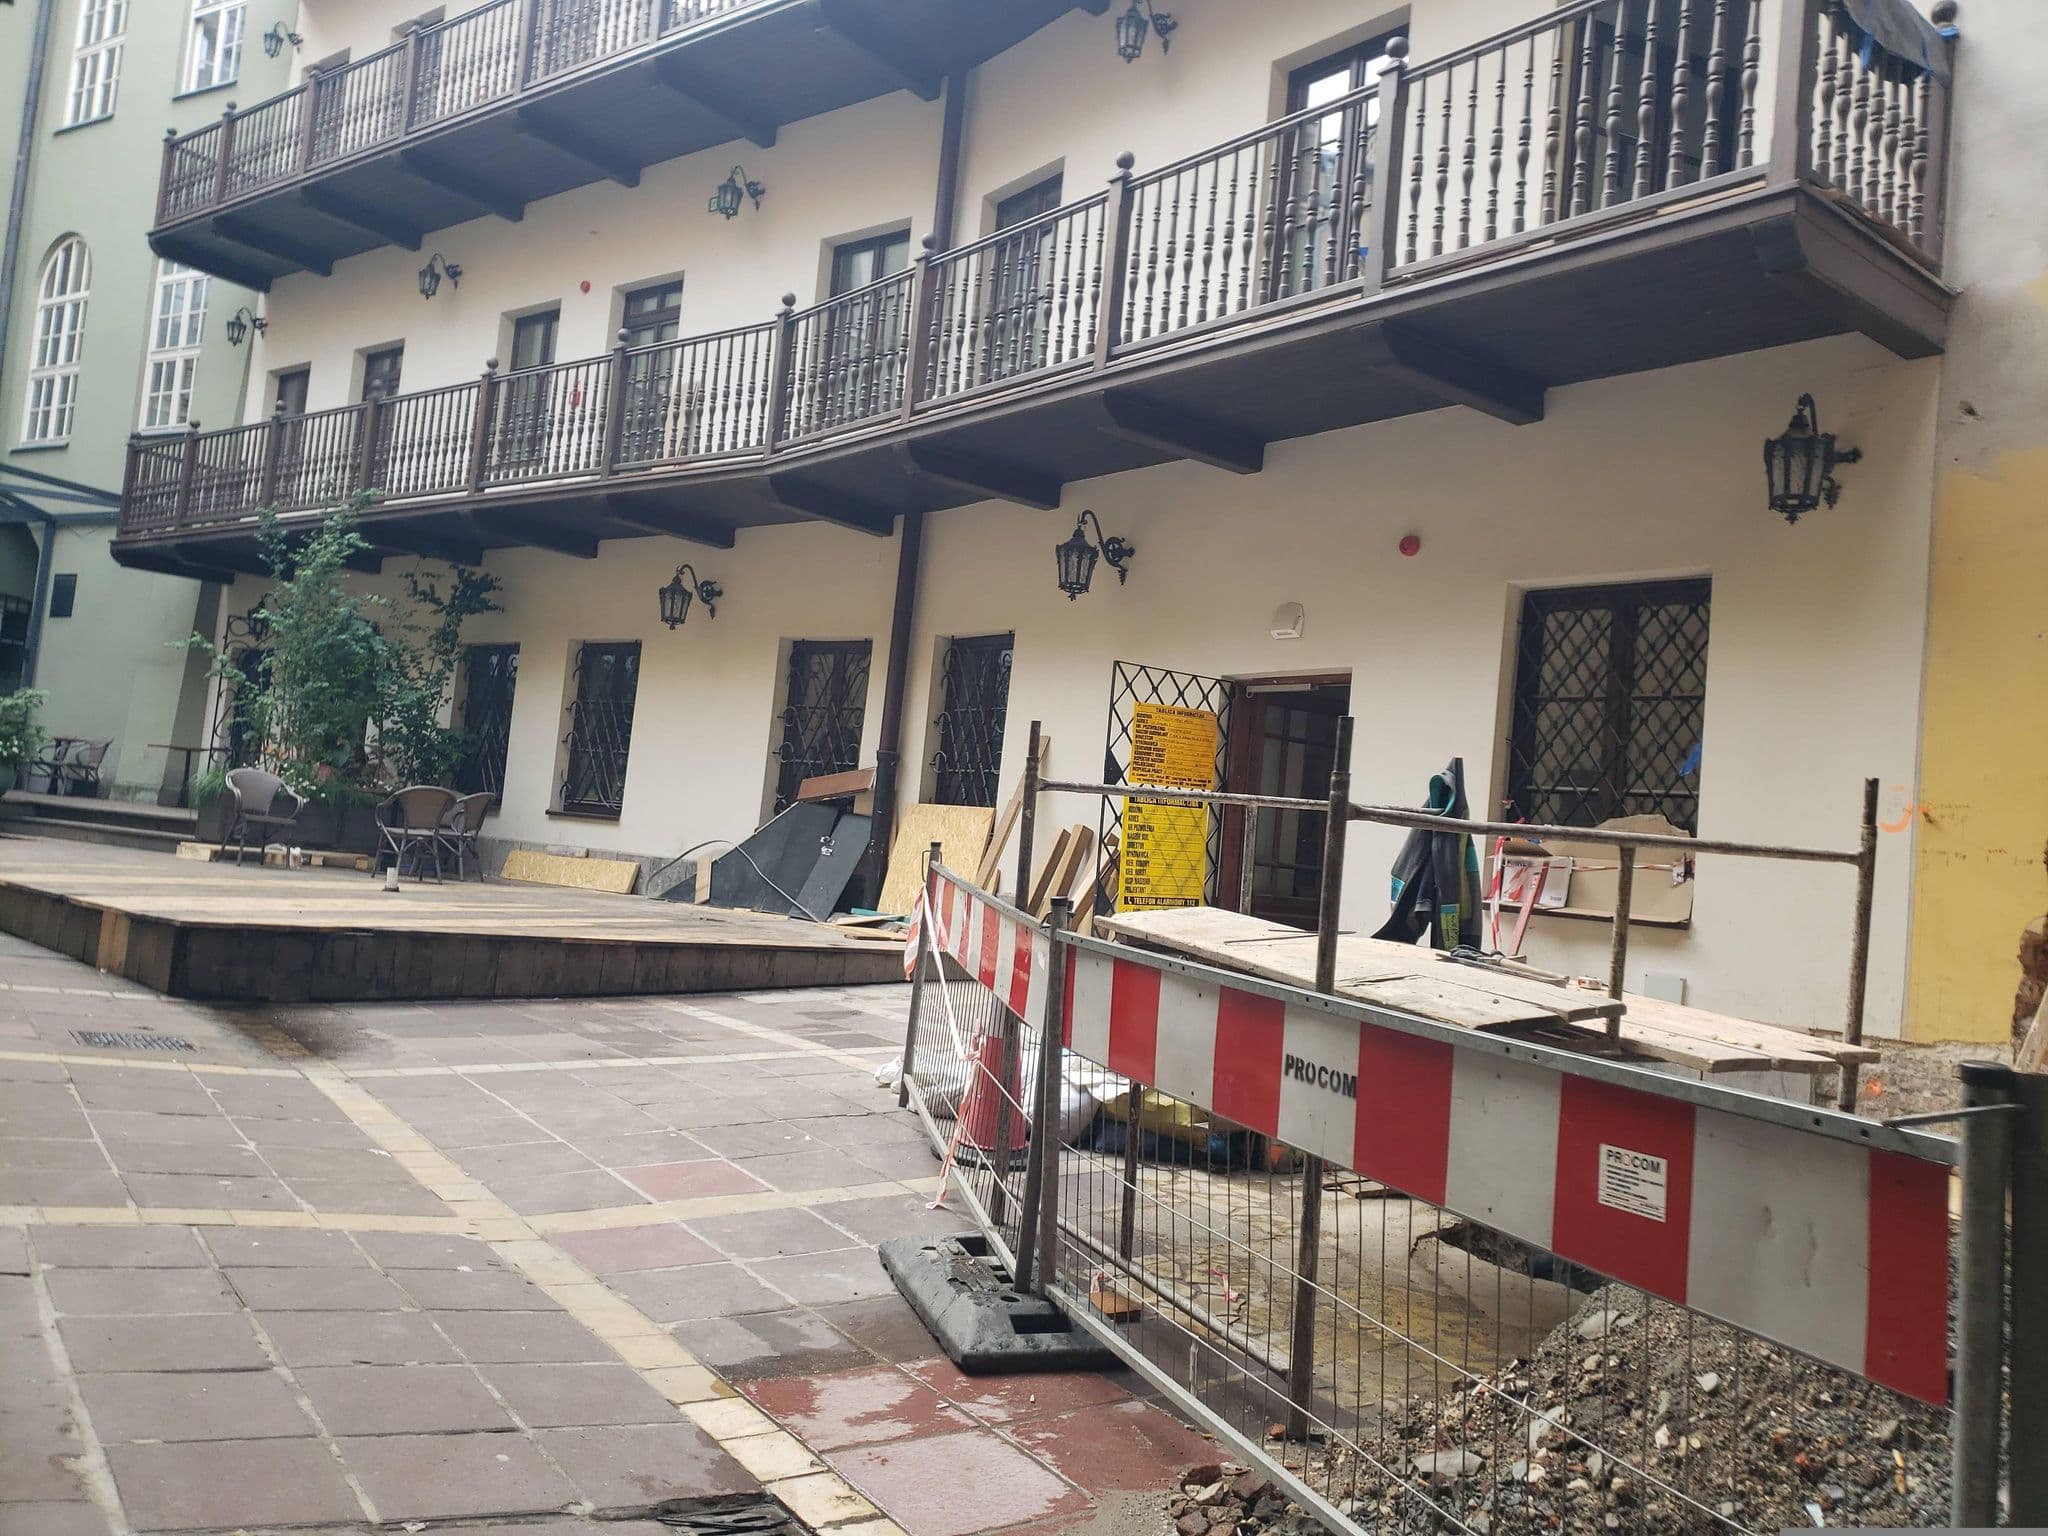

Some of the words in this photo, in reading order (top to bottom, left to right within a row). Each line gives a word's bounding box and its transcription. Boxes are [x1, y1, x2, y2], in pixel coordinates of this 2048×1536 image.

[1134, 897, 1156, 905] TELEFON
[1284, 1053, 1358, 1099] PROCOM
[1606, 1149, 1661, 1173] PROCOM
